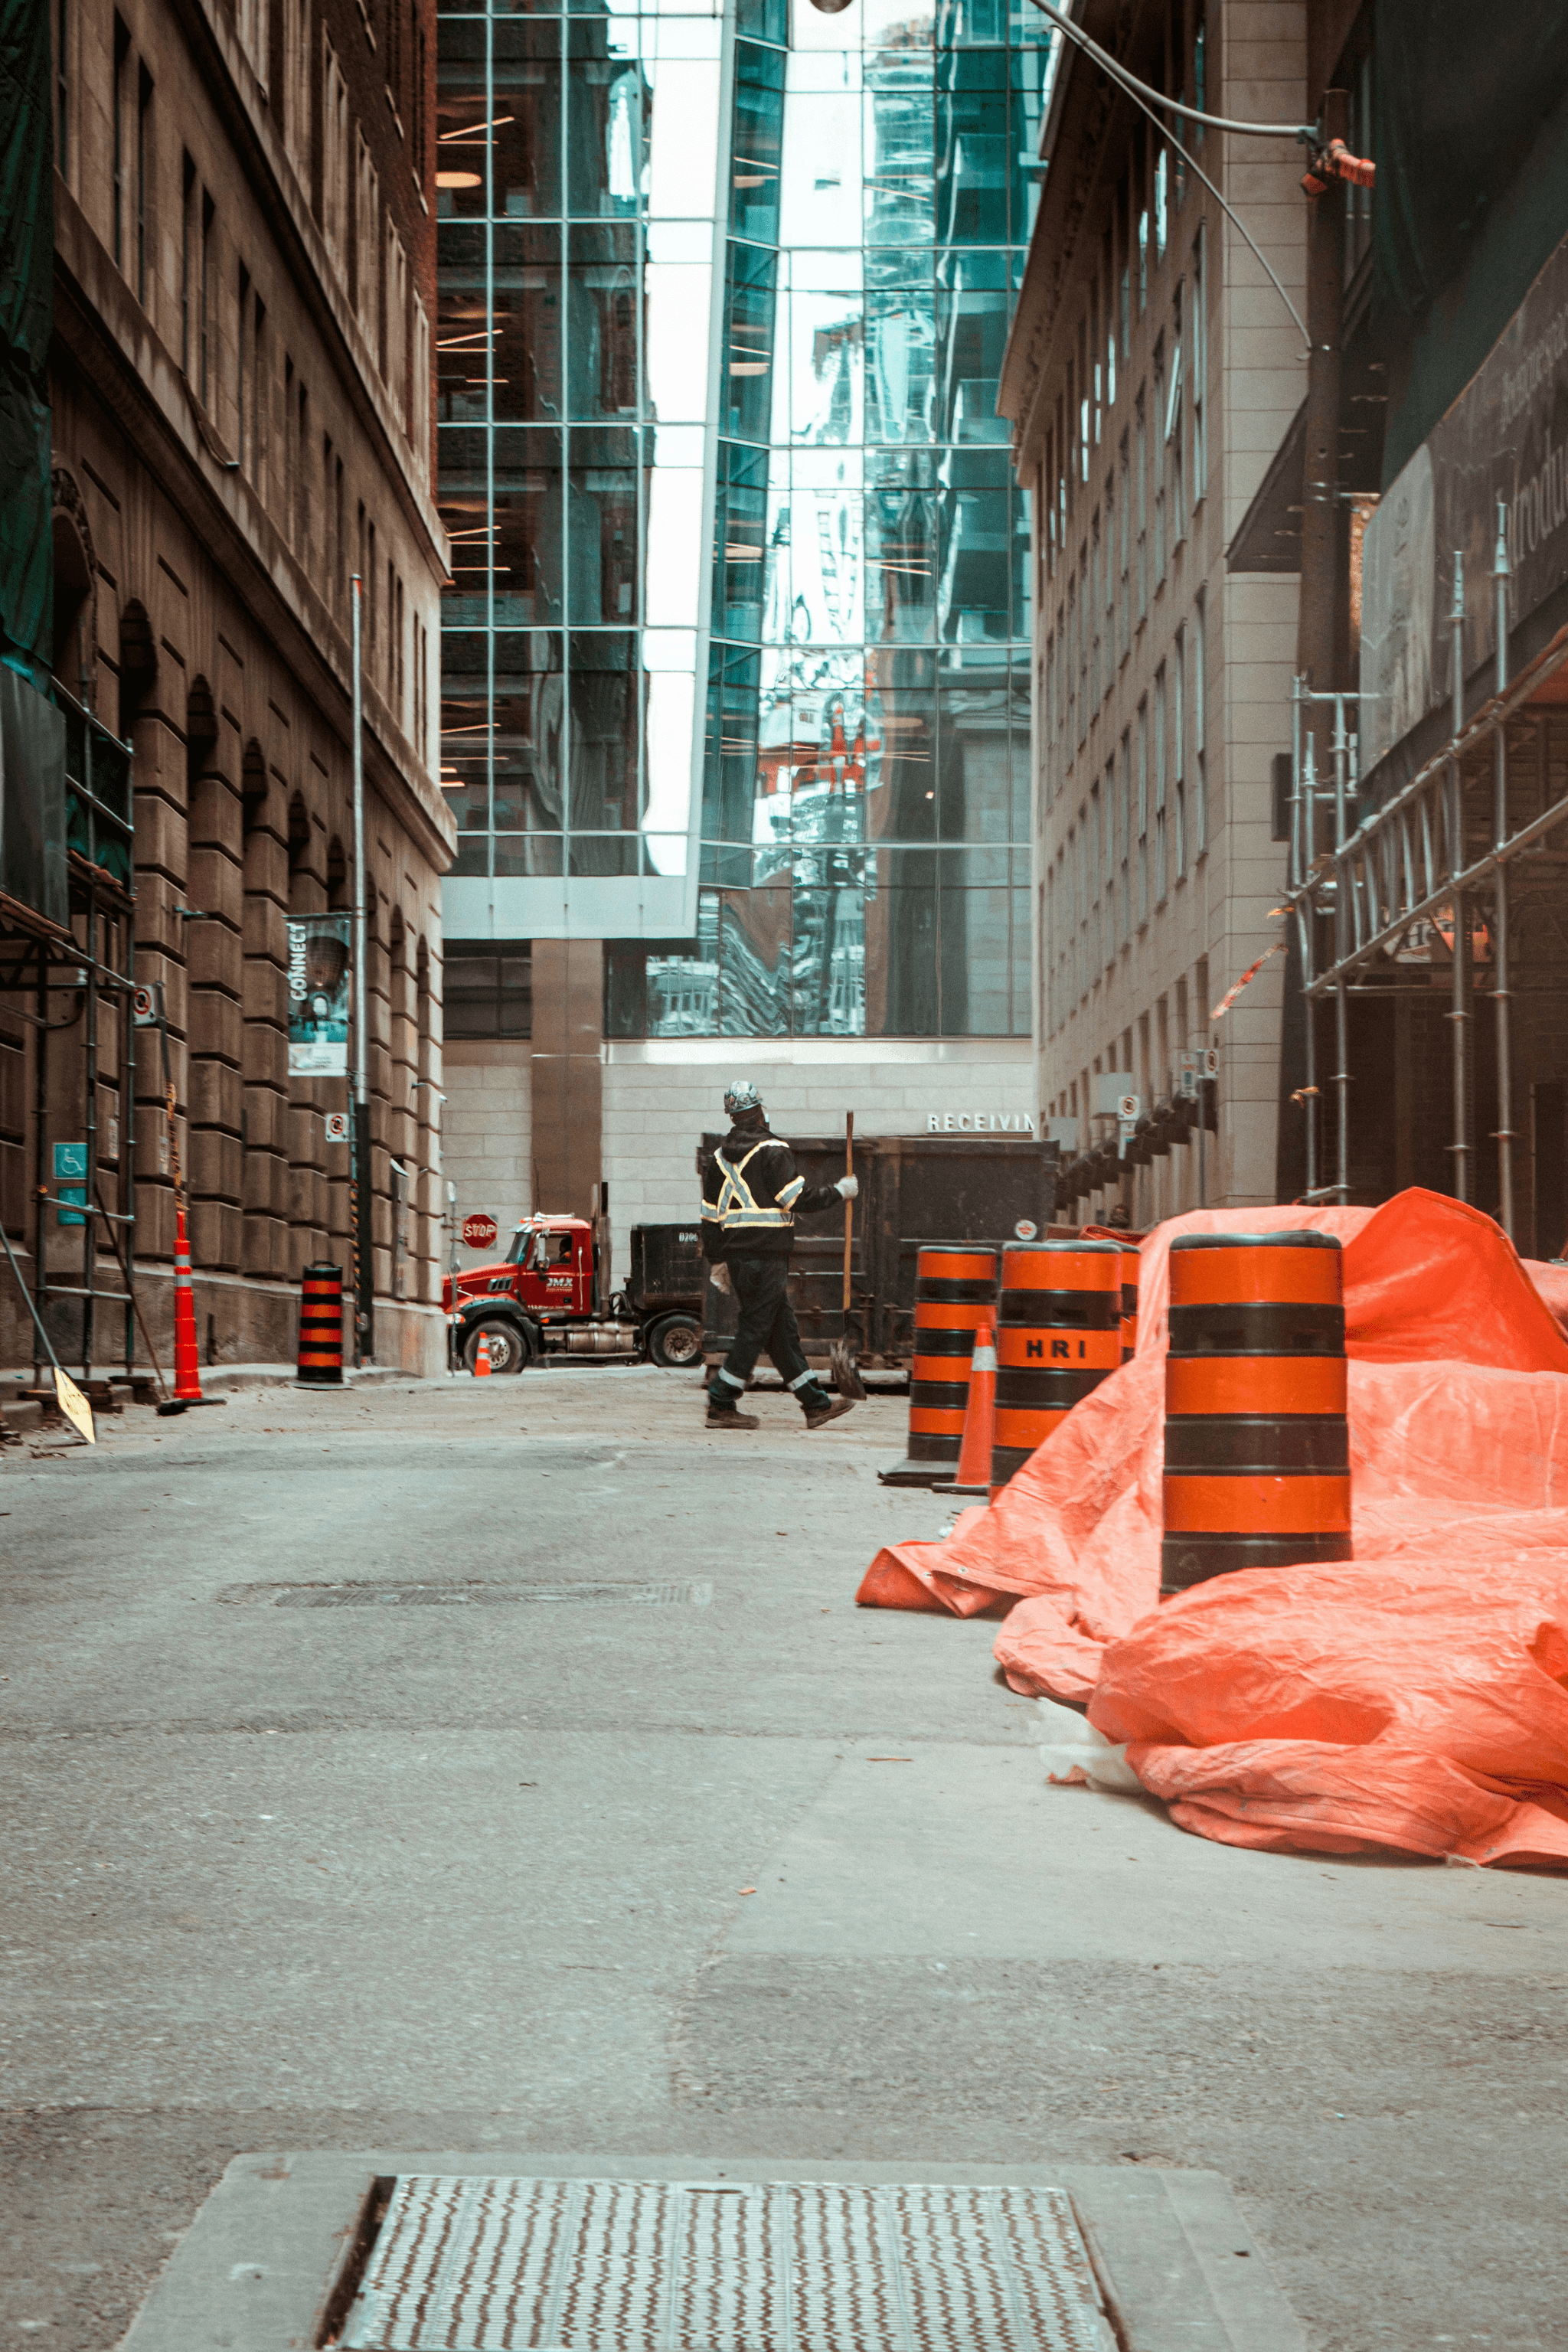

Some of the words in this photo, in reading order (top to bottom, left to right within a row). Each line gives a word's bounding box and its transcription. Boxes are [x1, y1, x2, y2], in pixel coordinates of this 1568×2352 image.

[289, 922, 308, 1001] CONNECT
[927, 1113, 1034, 1131] RECEIVIN
[464, 1223, 496, 1236] STOP
[547, 1277, 573, 1286] JMX
[1026, 1340, 1086, 1358] HRI
